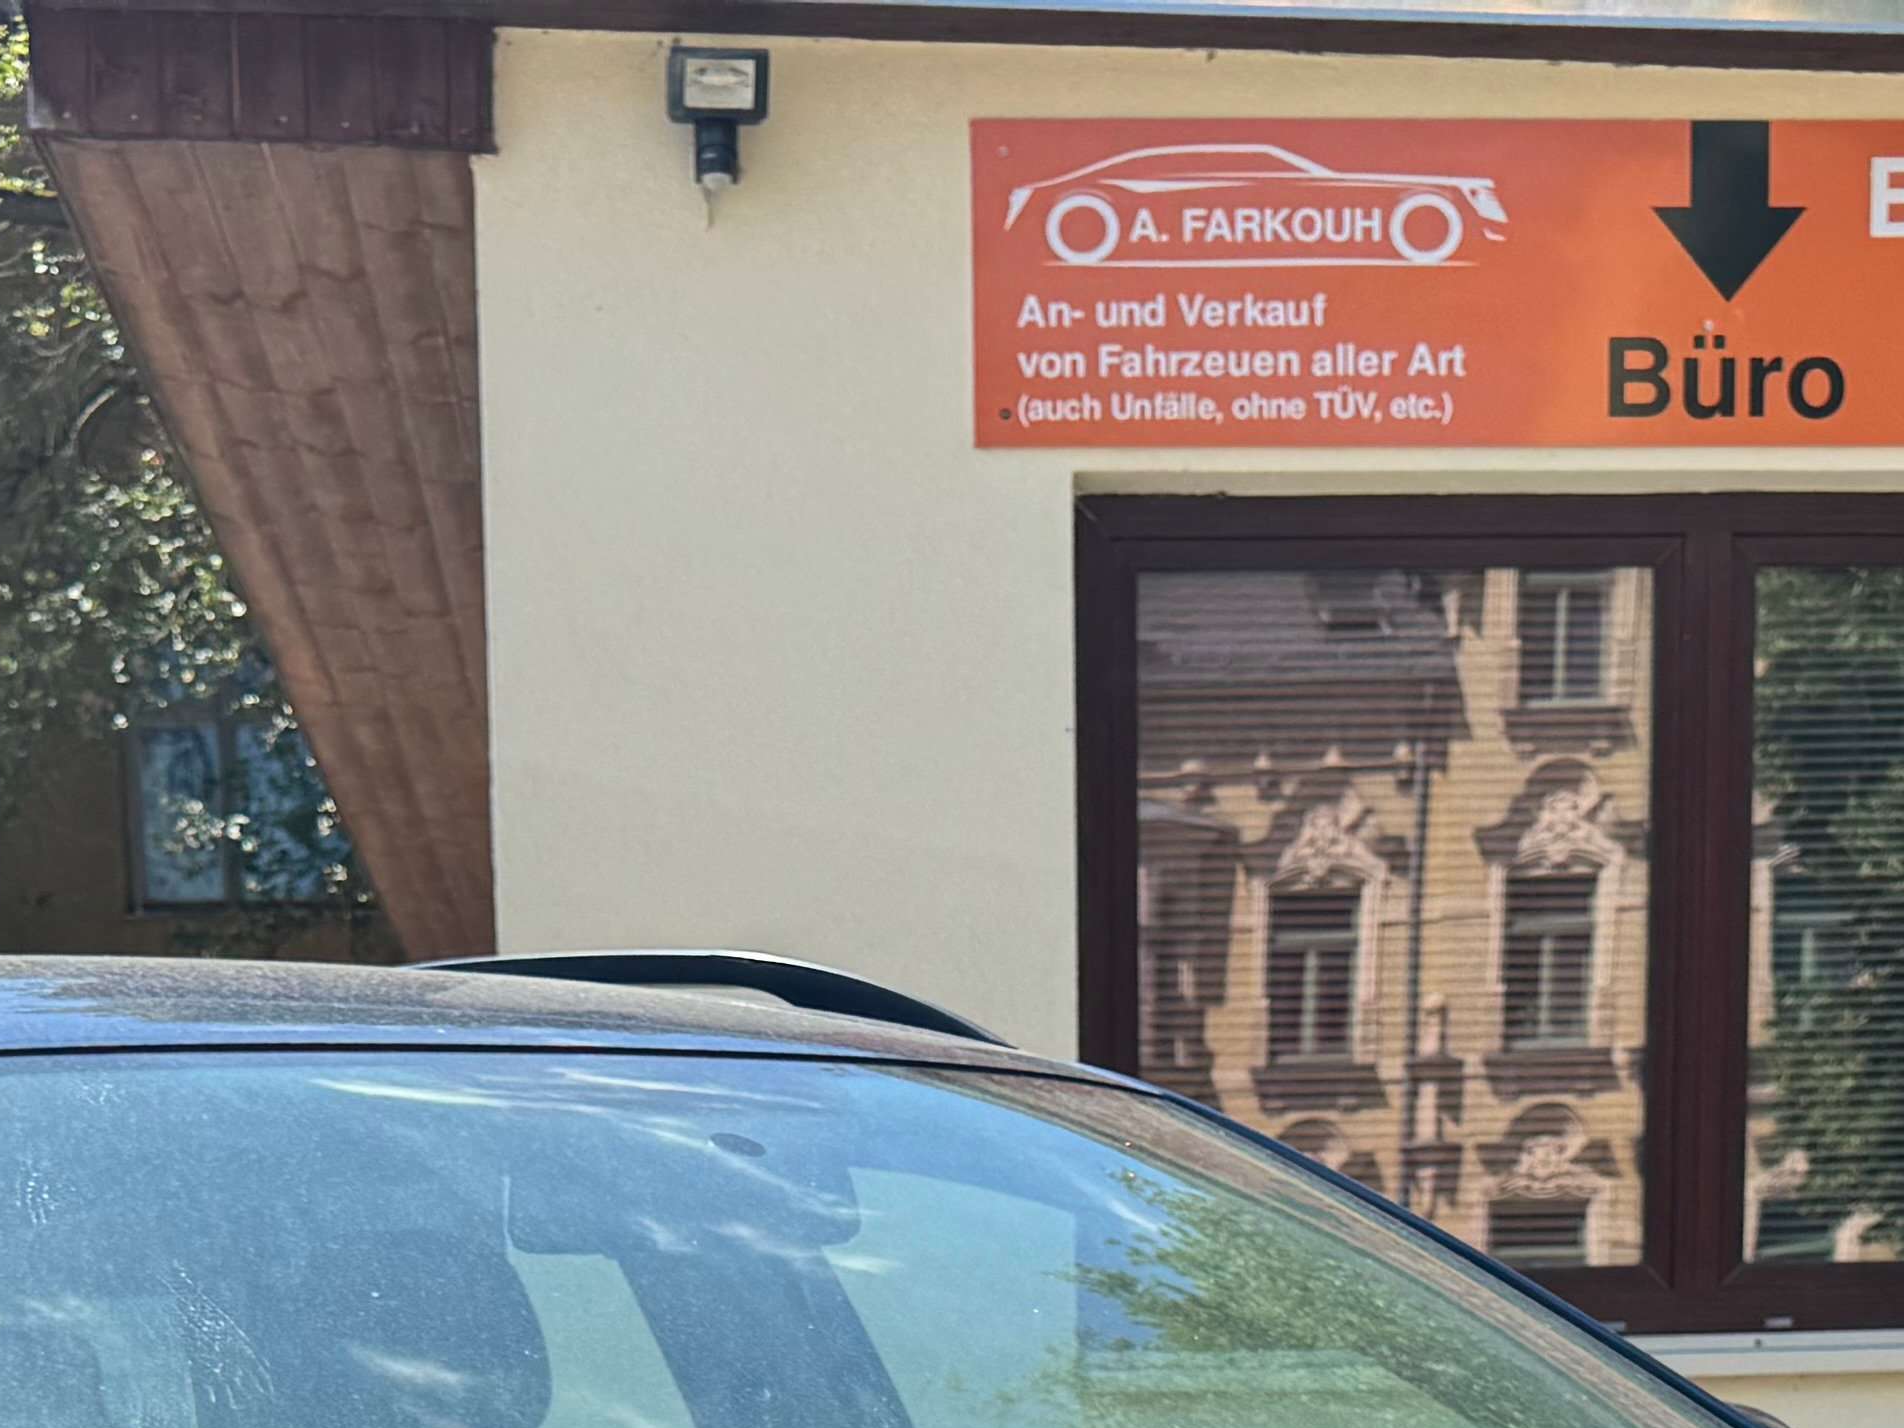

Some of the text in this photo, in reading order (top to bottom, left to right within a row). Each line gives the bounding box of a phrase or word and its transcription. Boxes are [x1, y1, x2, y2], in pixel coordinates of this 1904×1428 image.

[1129, 207, 1382, 243] A. FARKOUH
[1017, 293, 1326, 328] An- und Verkauf
[1017, 342, 1466, 379] von Fahrzeuen aller Art
[1608, 334, 1846, 420] Büro
[1017, 384, 1453, 427] (auch Unfälle, ohne TÜV, etc.)
